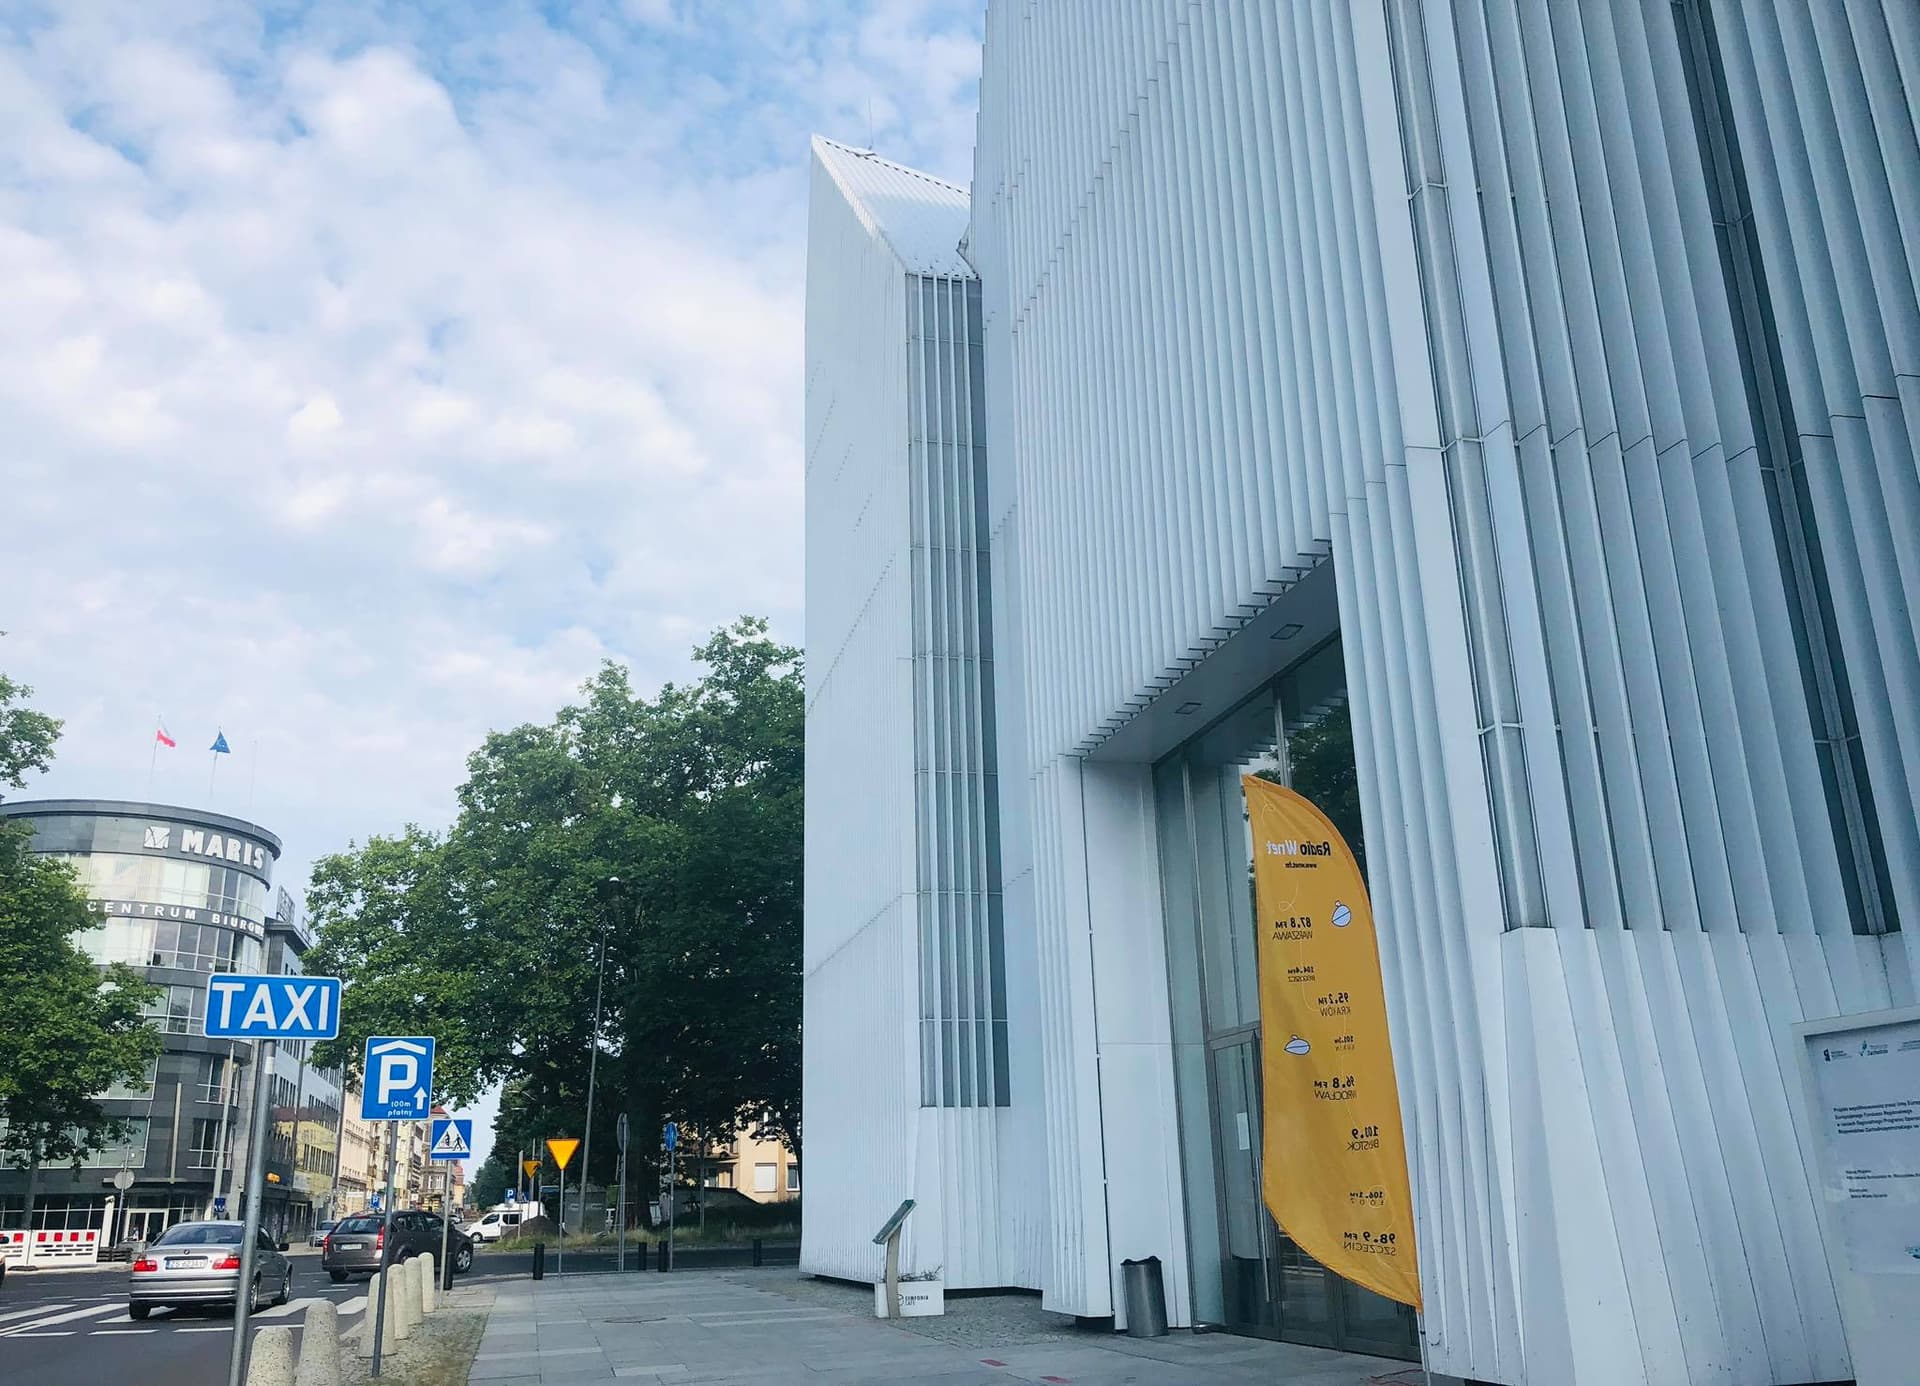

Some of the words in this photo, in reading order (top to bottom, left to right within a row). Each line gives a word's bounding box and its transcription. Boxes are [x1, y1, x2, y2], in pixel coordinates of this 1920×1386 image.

[181, 829, 265, 870] MARIS
[87, 901, 196, 921] CENTRUM
[212, 982, 330, 1031] TAXI
[378, 1055, 418, 1104] P
